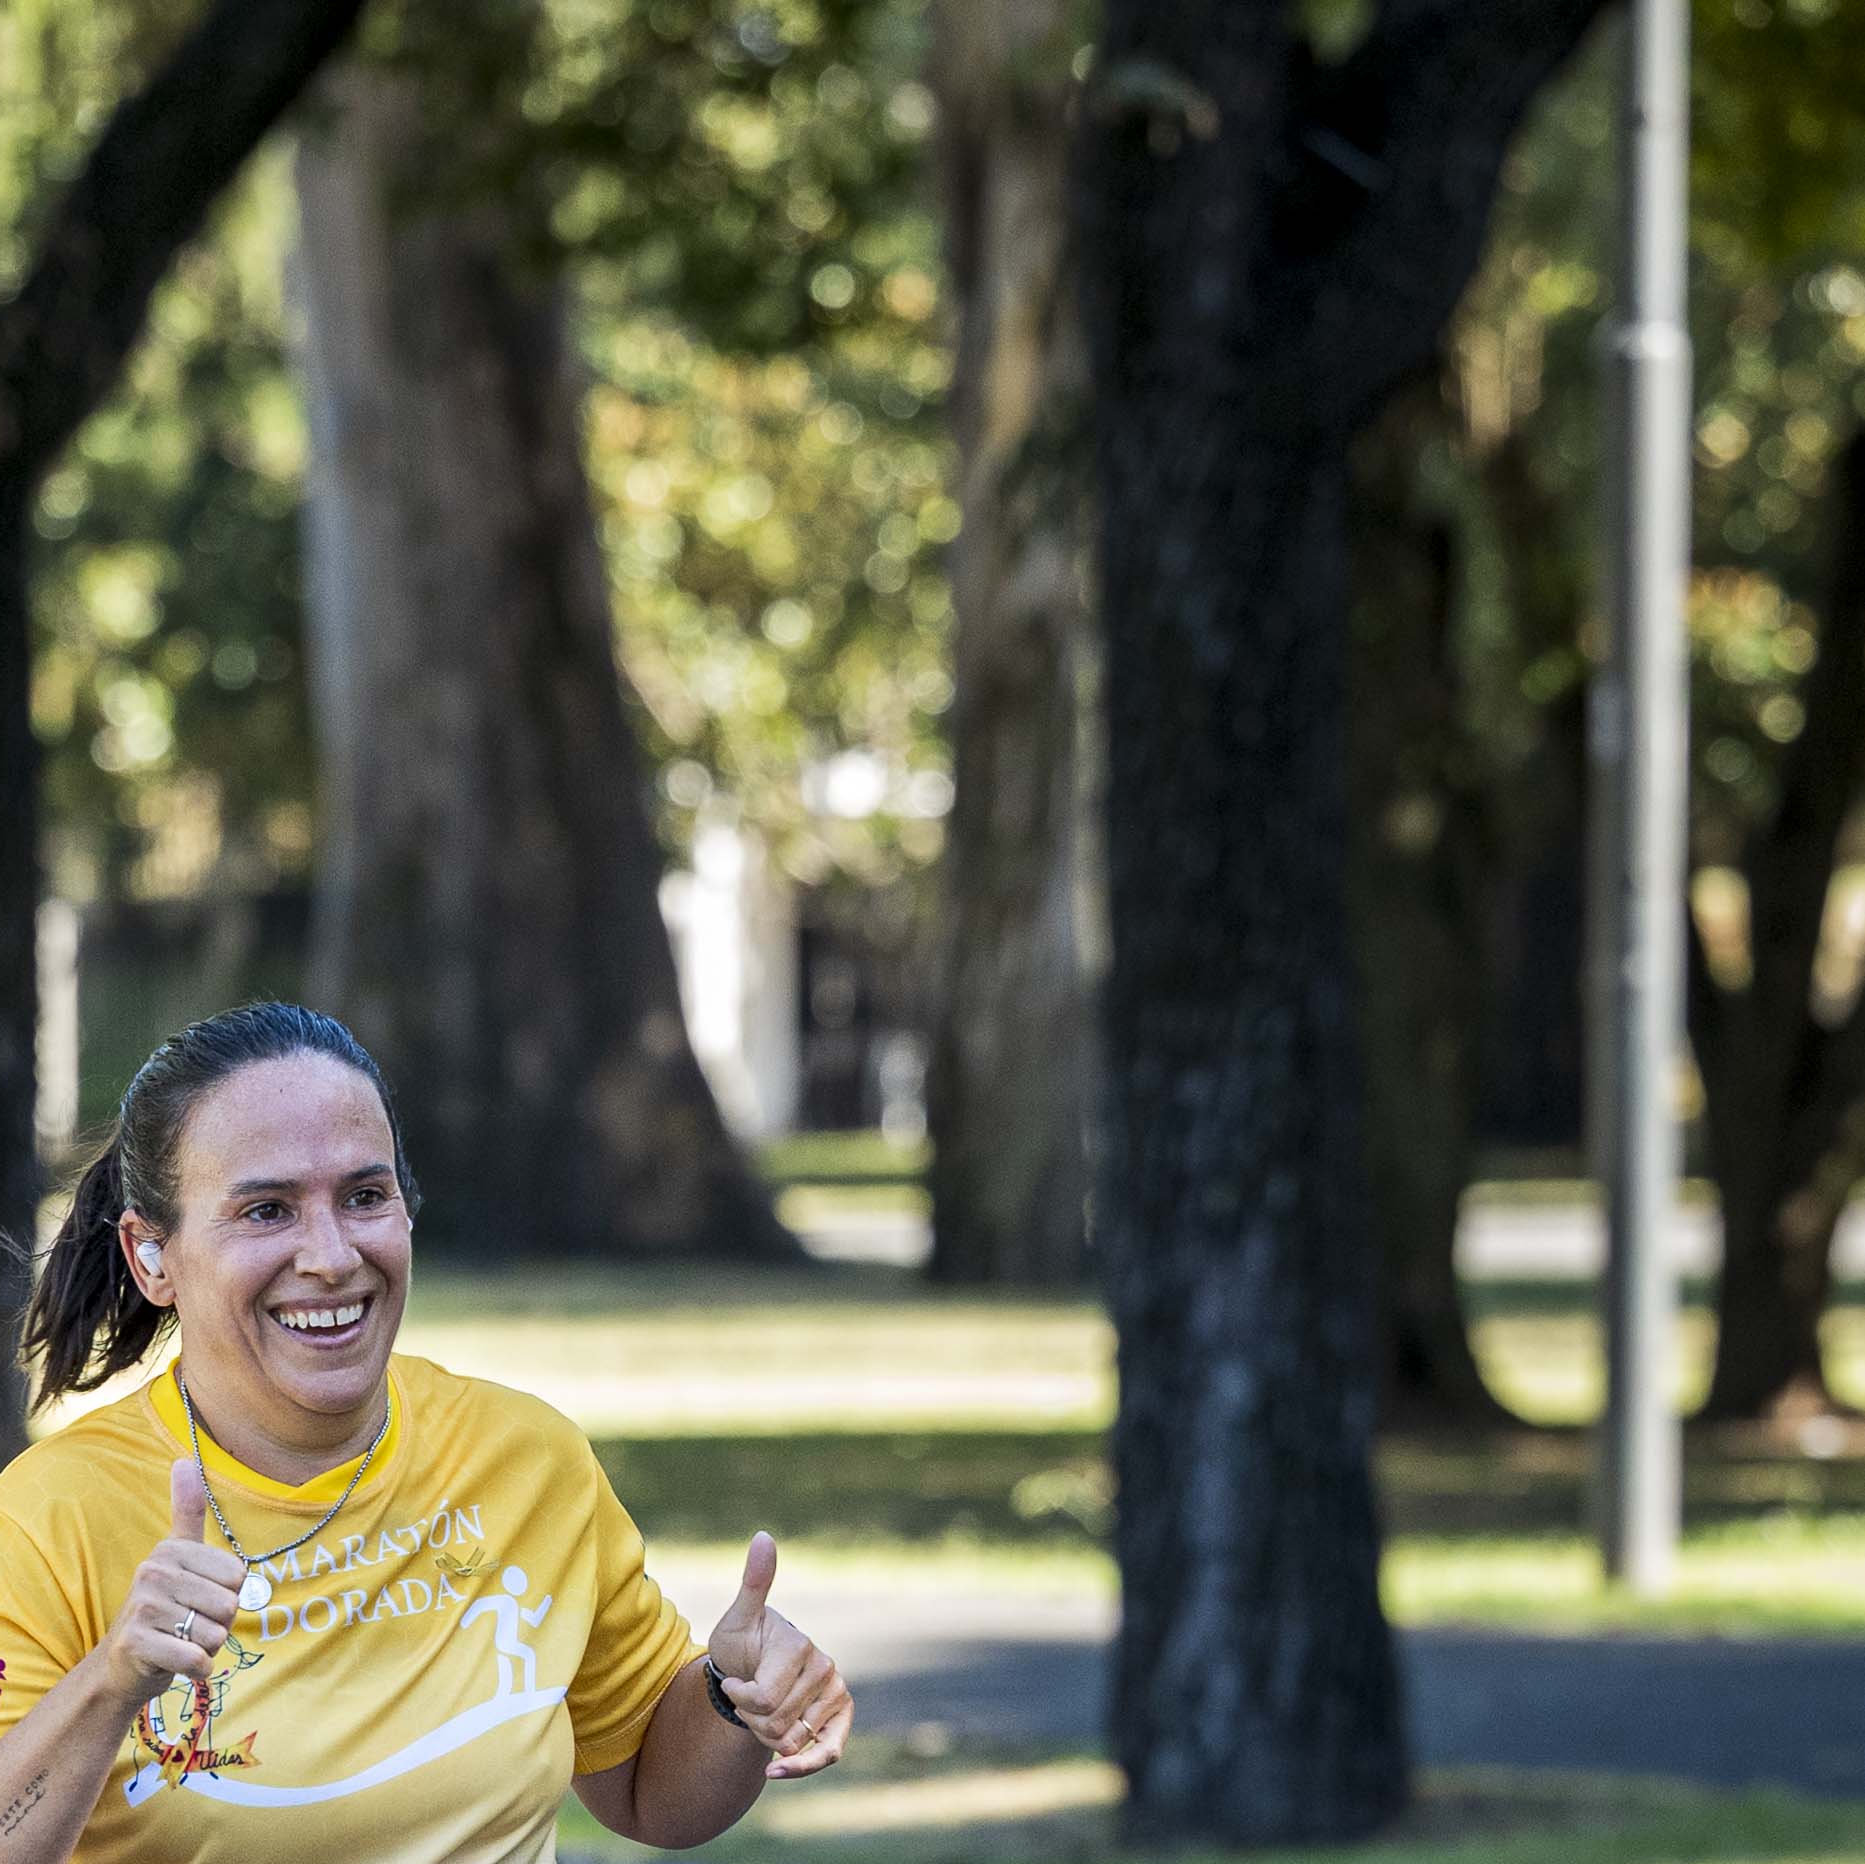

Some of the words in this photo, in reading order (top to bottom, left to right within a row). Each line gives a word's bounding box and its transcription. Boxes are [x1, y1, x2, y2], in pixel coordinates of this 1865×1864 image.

[258, 1498, 486, 1585] MARATÓN
[258, 1573, 467, 1643] DORADA
[25, 1769, 49, 1795] COMO
